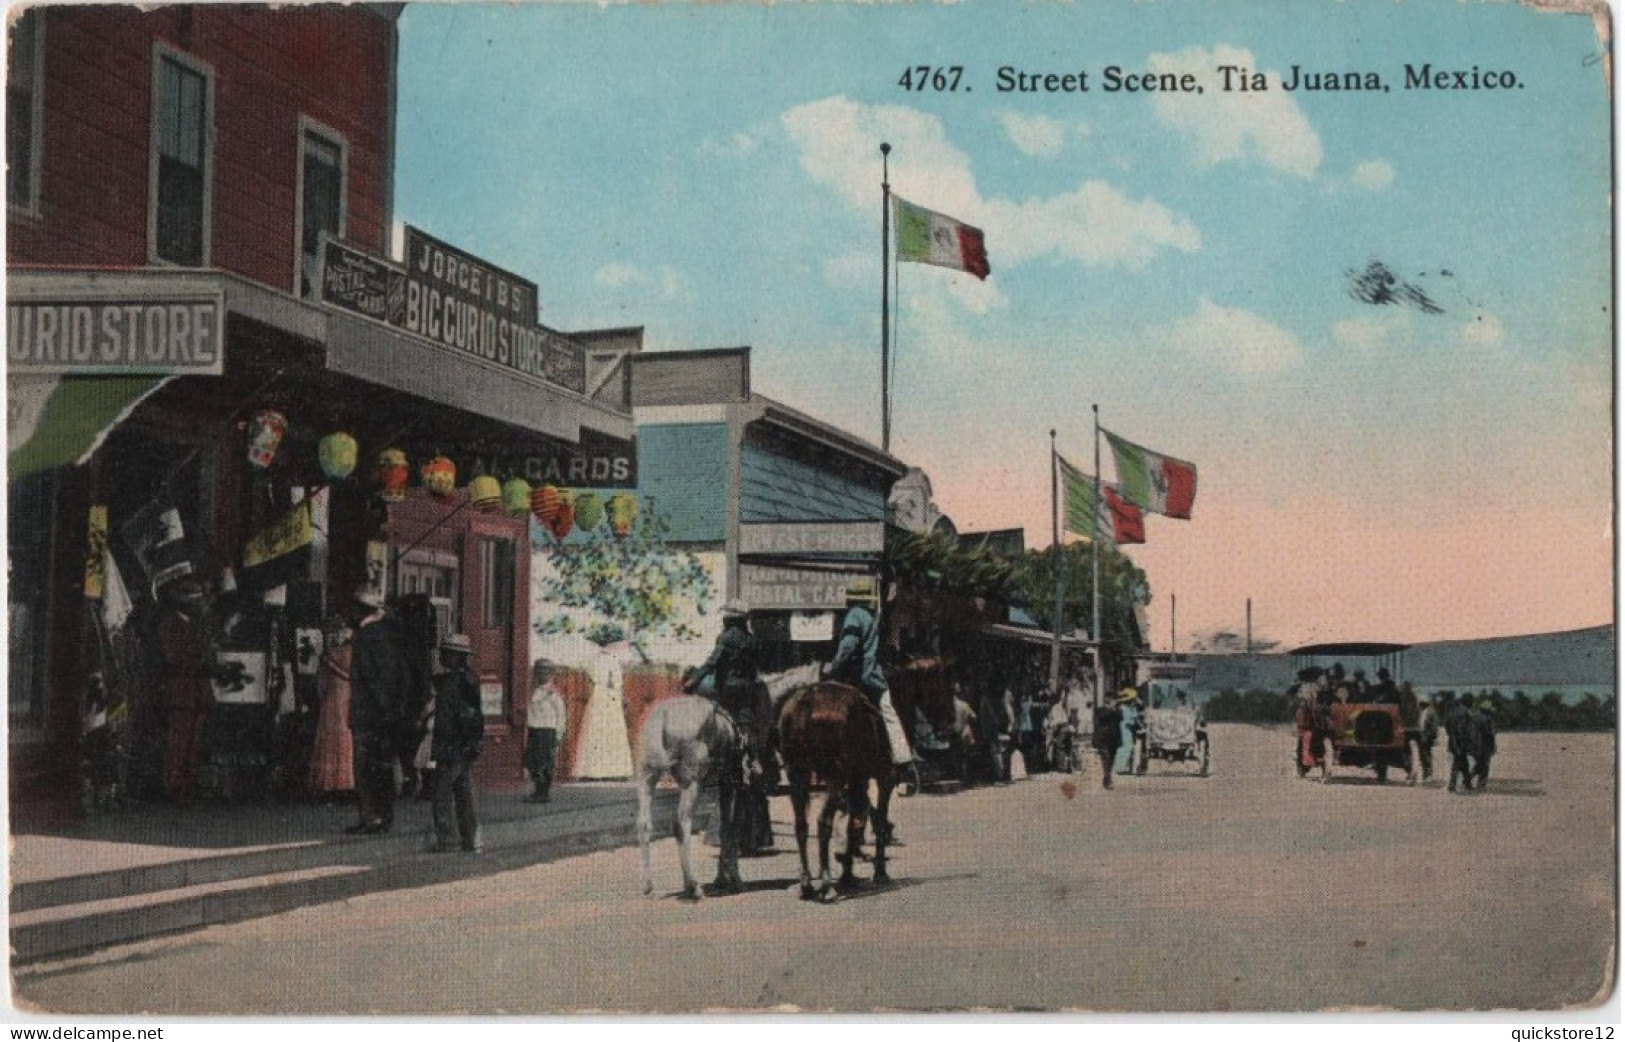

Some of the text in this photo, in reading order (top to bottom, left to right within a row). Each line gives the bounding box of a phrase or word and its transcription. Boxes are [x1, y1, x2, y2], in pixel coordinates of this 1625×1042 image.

[9, 305, 215, 362] URIO STORE
[443, 296, 498, 360] CURIO
[499, 319, 547, 377] STORE
[525, 455, 630, 482] CARDS
[812, 585, 847, 605] CAR
